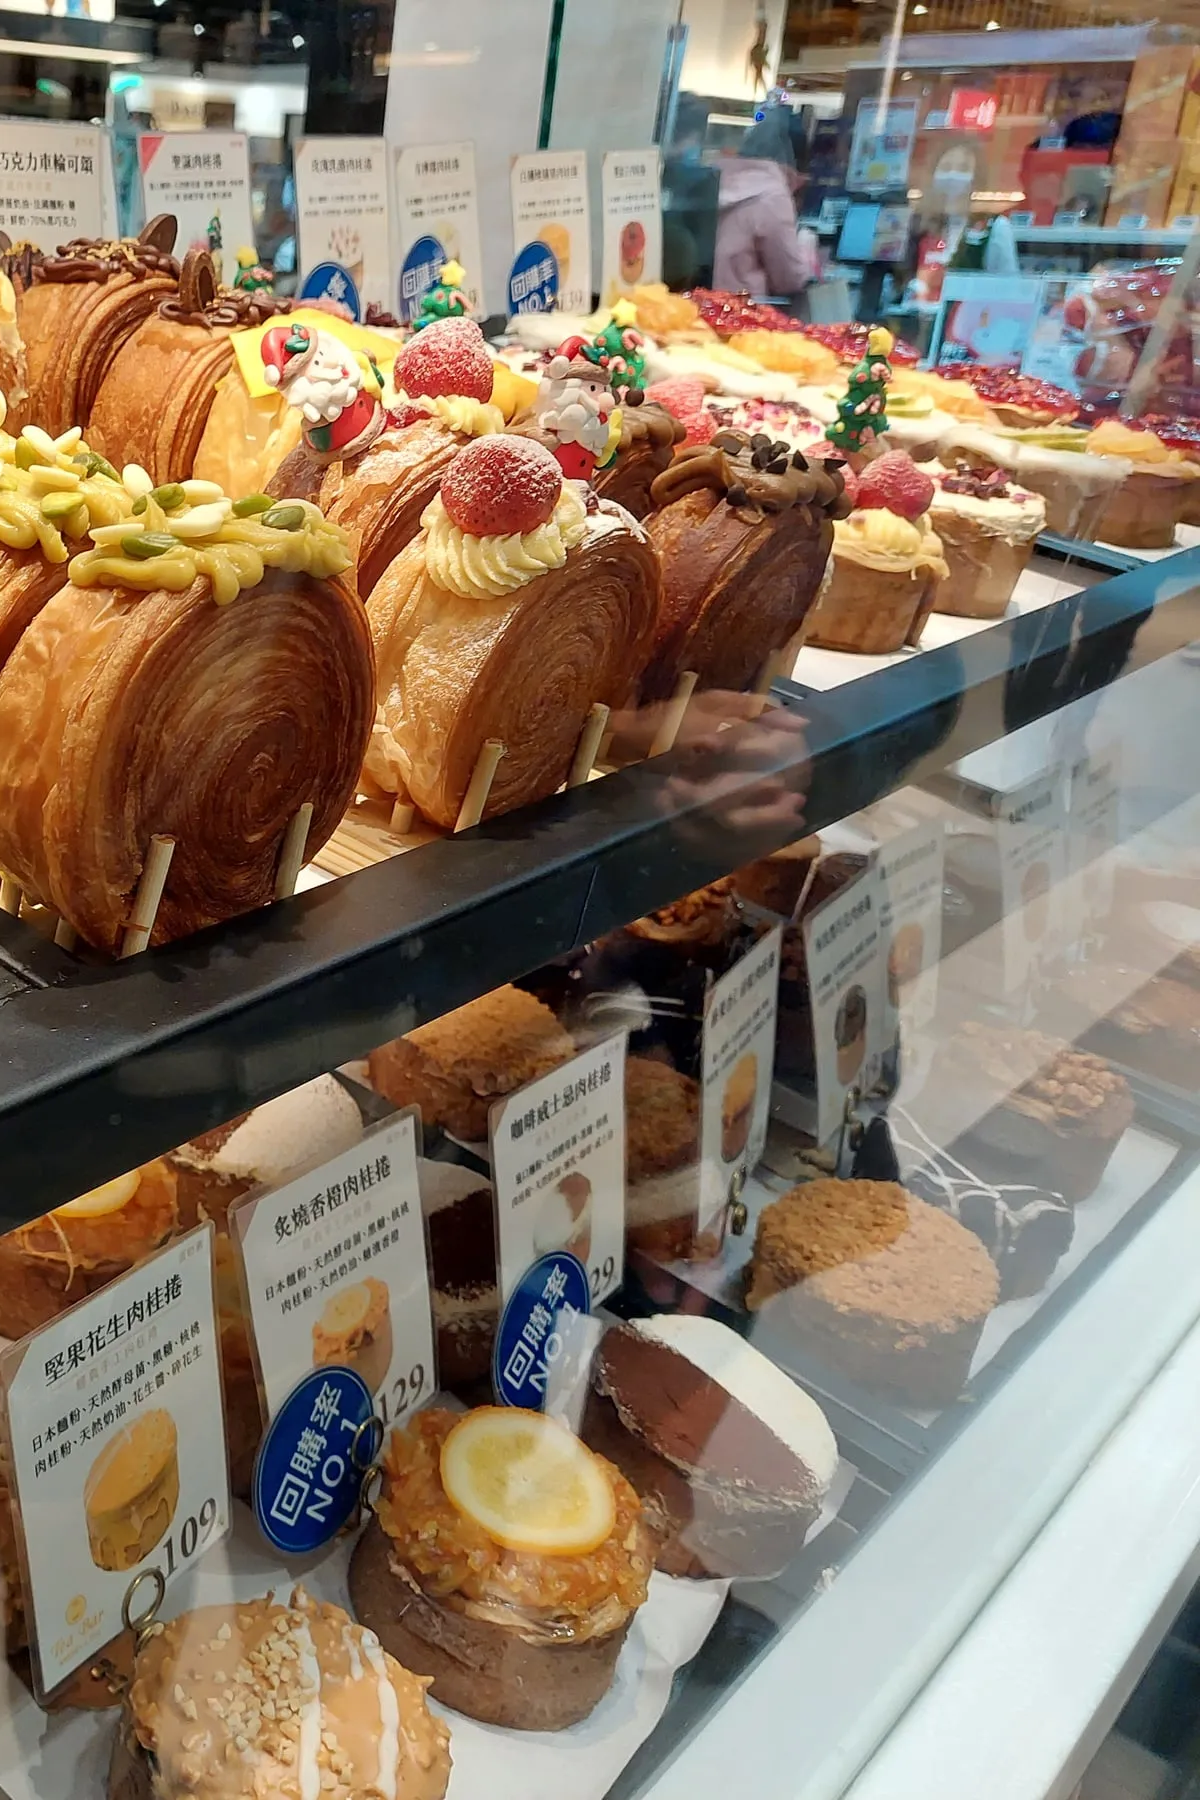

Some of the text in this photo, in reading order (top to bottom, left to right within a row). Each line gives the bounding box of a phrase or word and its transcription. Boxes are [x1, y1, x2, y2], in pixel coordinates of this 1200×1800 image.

[274, 1155, 391, 1244] 炙燒香橙肉桂捲
[45, 1274, 183, 1387] 堅果花生肉桂捲
[503, 1263, 569, 1390] 回購率
[270, 1381, 342, 1527] 回購率
